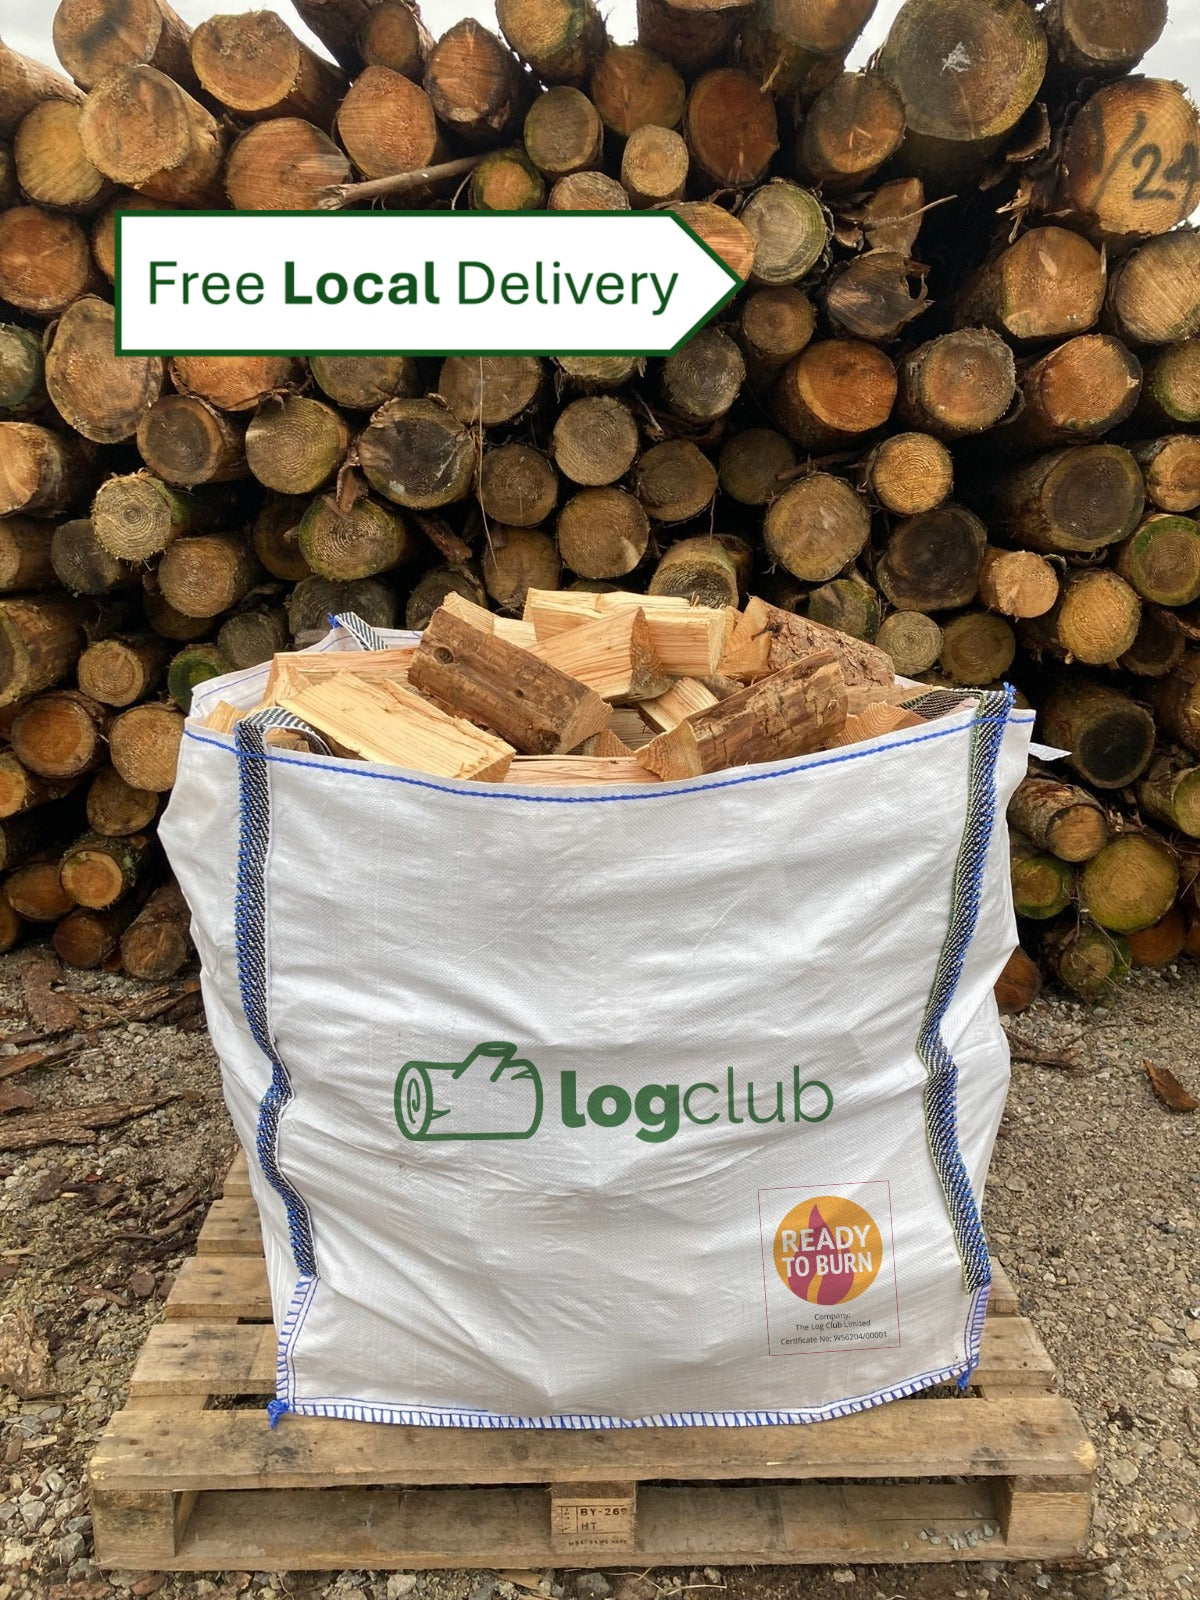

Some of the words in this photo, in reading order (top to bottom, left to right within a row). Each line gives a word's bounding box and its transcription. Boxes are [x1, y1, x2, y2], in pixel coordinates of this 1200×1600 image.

[561, 1065, 833, 1143] logclub
[781, 1224, 871, 1253] READY
[782, 1255, 810, 1278] TO
[816, 1251, 873, 1276] BURN
[814, 1312, 851, 1321] Company:
[811, 1323, 824, 1331] Log
[826, 1321, 842, 1329] Club
[844, 1319, 871, 1328] Limited
[780, 1336, 817, 1345] Certificate
[820, 1335, 832, 1343] No:
[581, 1521, 597, 1531] HT
